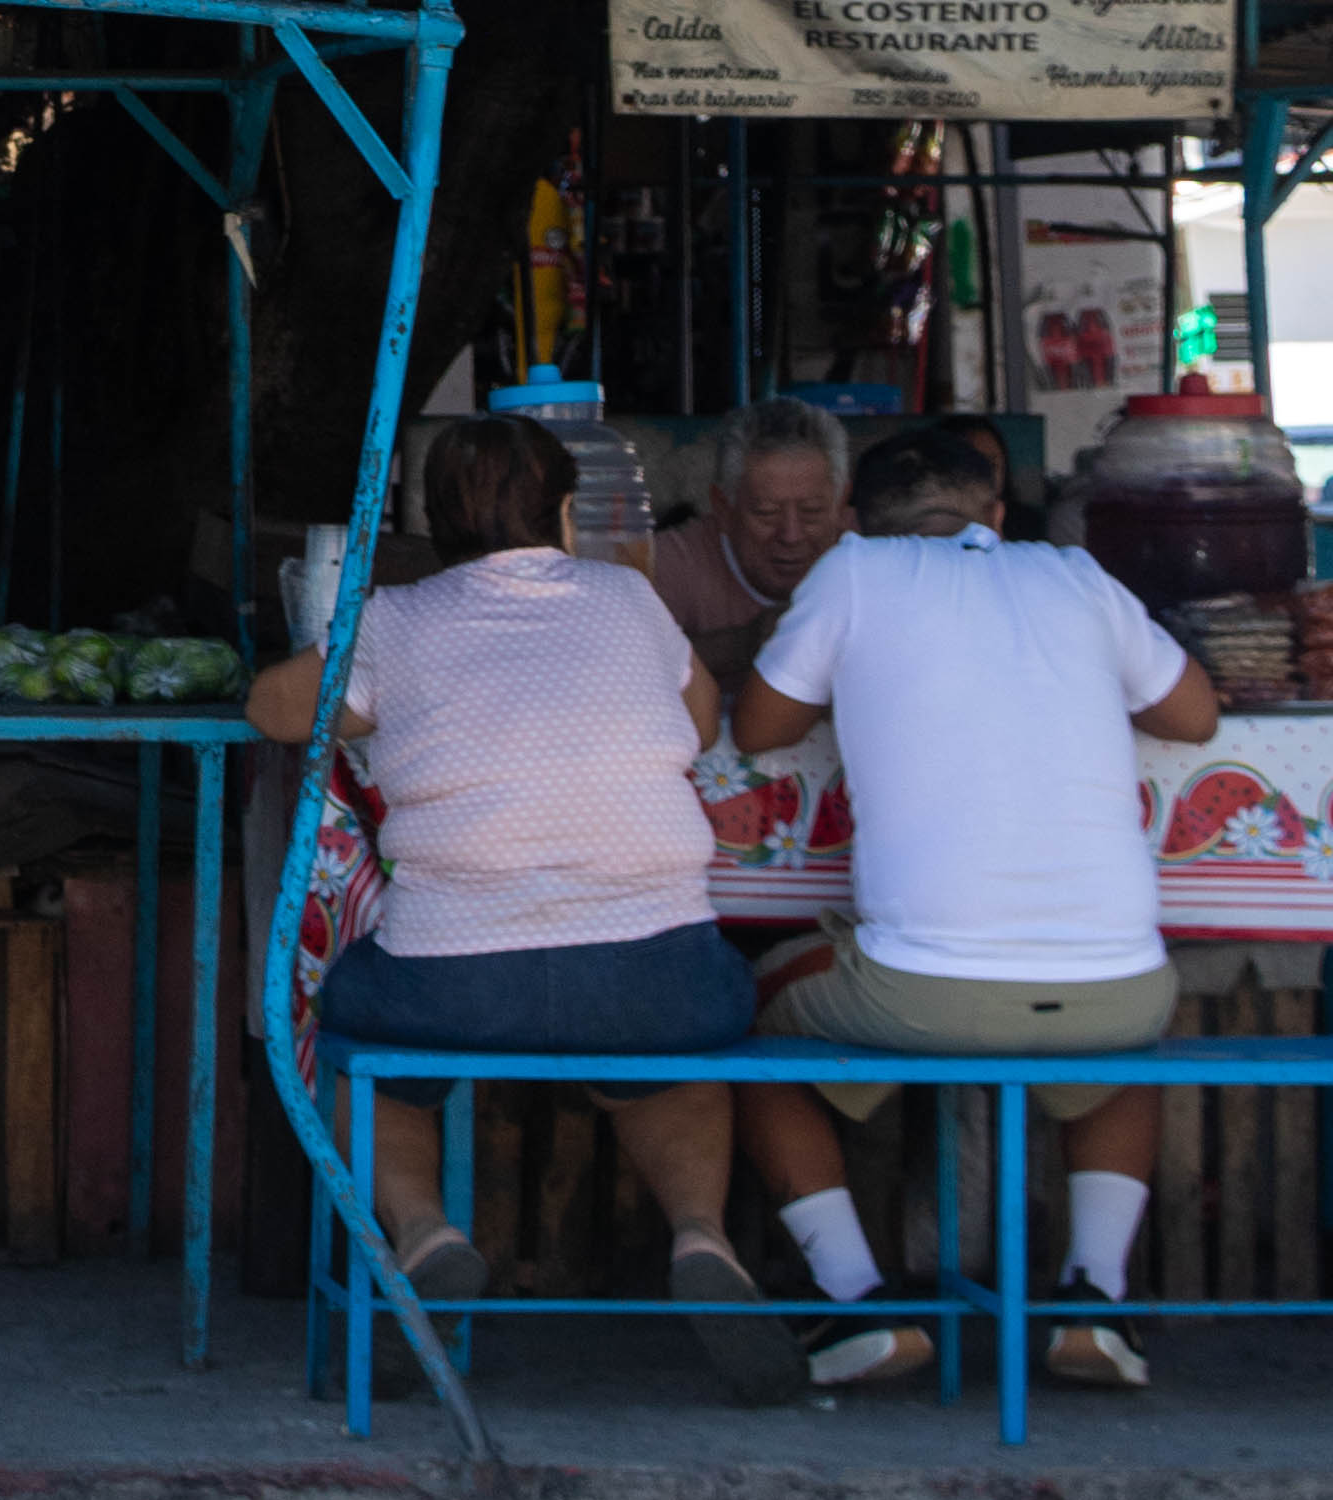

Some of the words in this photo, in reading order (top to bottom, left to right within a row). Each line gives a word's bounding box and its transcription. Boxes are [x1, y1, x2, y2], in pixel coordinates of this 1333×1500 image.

[793, 0, 831, 21] EL
[642, 16, 723, 41] Caldos
[806, 29, 1040, 52] RESTAURANTE
[1138, 23, 1227, 52] Alitas
